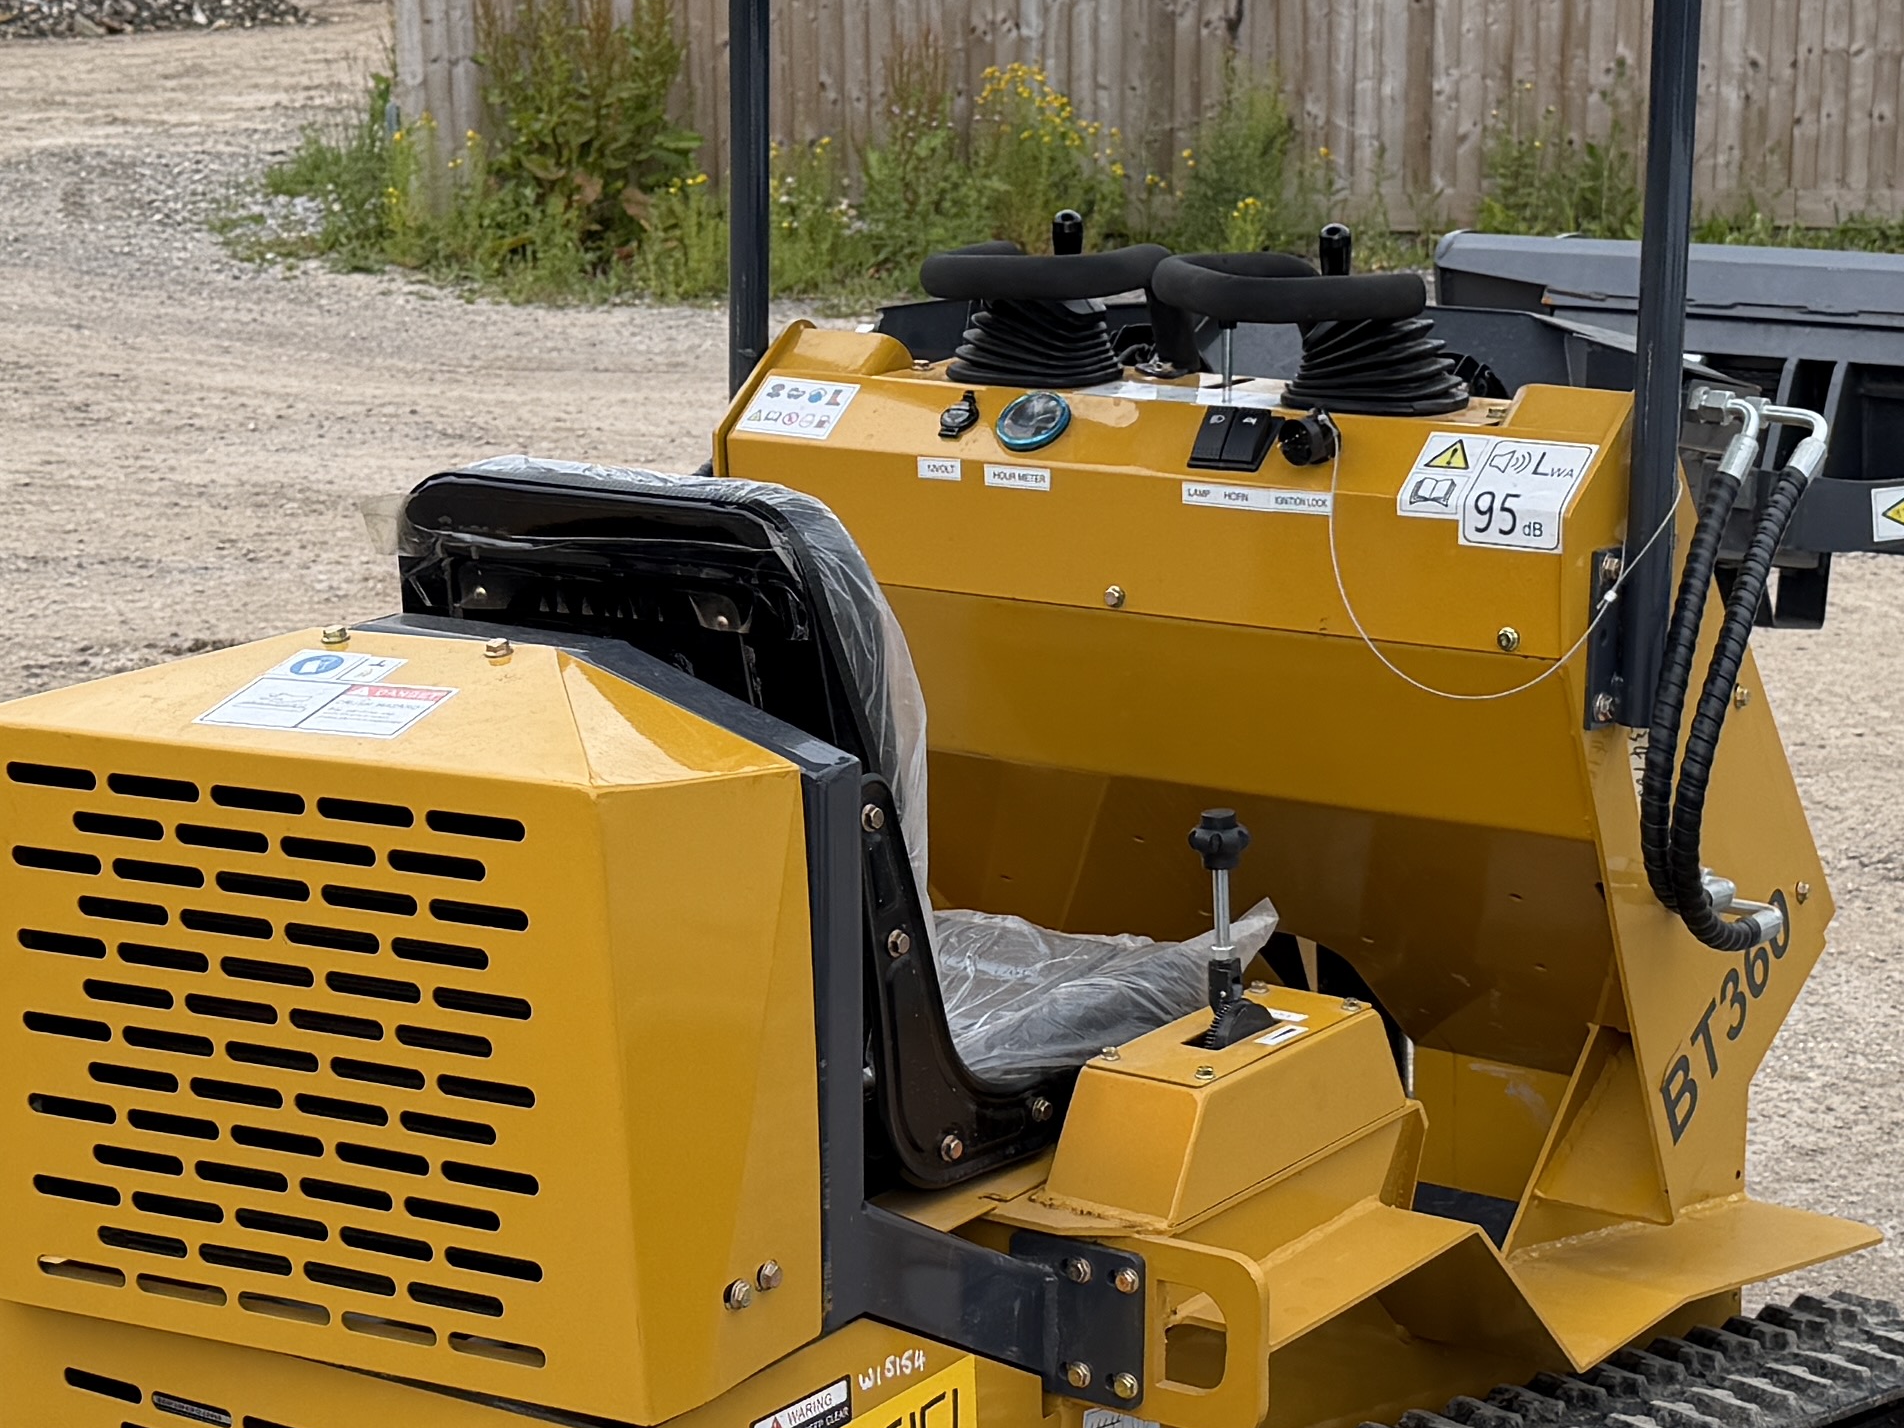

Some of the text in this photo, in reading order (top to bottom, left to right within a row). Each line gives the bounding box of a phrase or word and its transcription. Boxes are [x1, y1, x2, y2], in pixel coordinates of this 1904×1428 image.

[992, 471, 1046, 484] HOUR METER
[1187, 487, 1211, 498] LAMP
[1223, 491, 1249, 502] HORN
[1274, 495, 1306, 507] IGNITION
[1473, 490, 1544, 539] 95 dB
[858, 1349, 927, 1392] W15154
[787, 1392, 833, 1426] WARING
[826, 1406, 849, 1428] CLEAR
